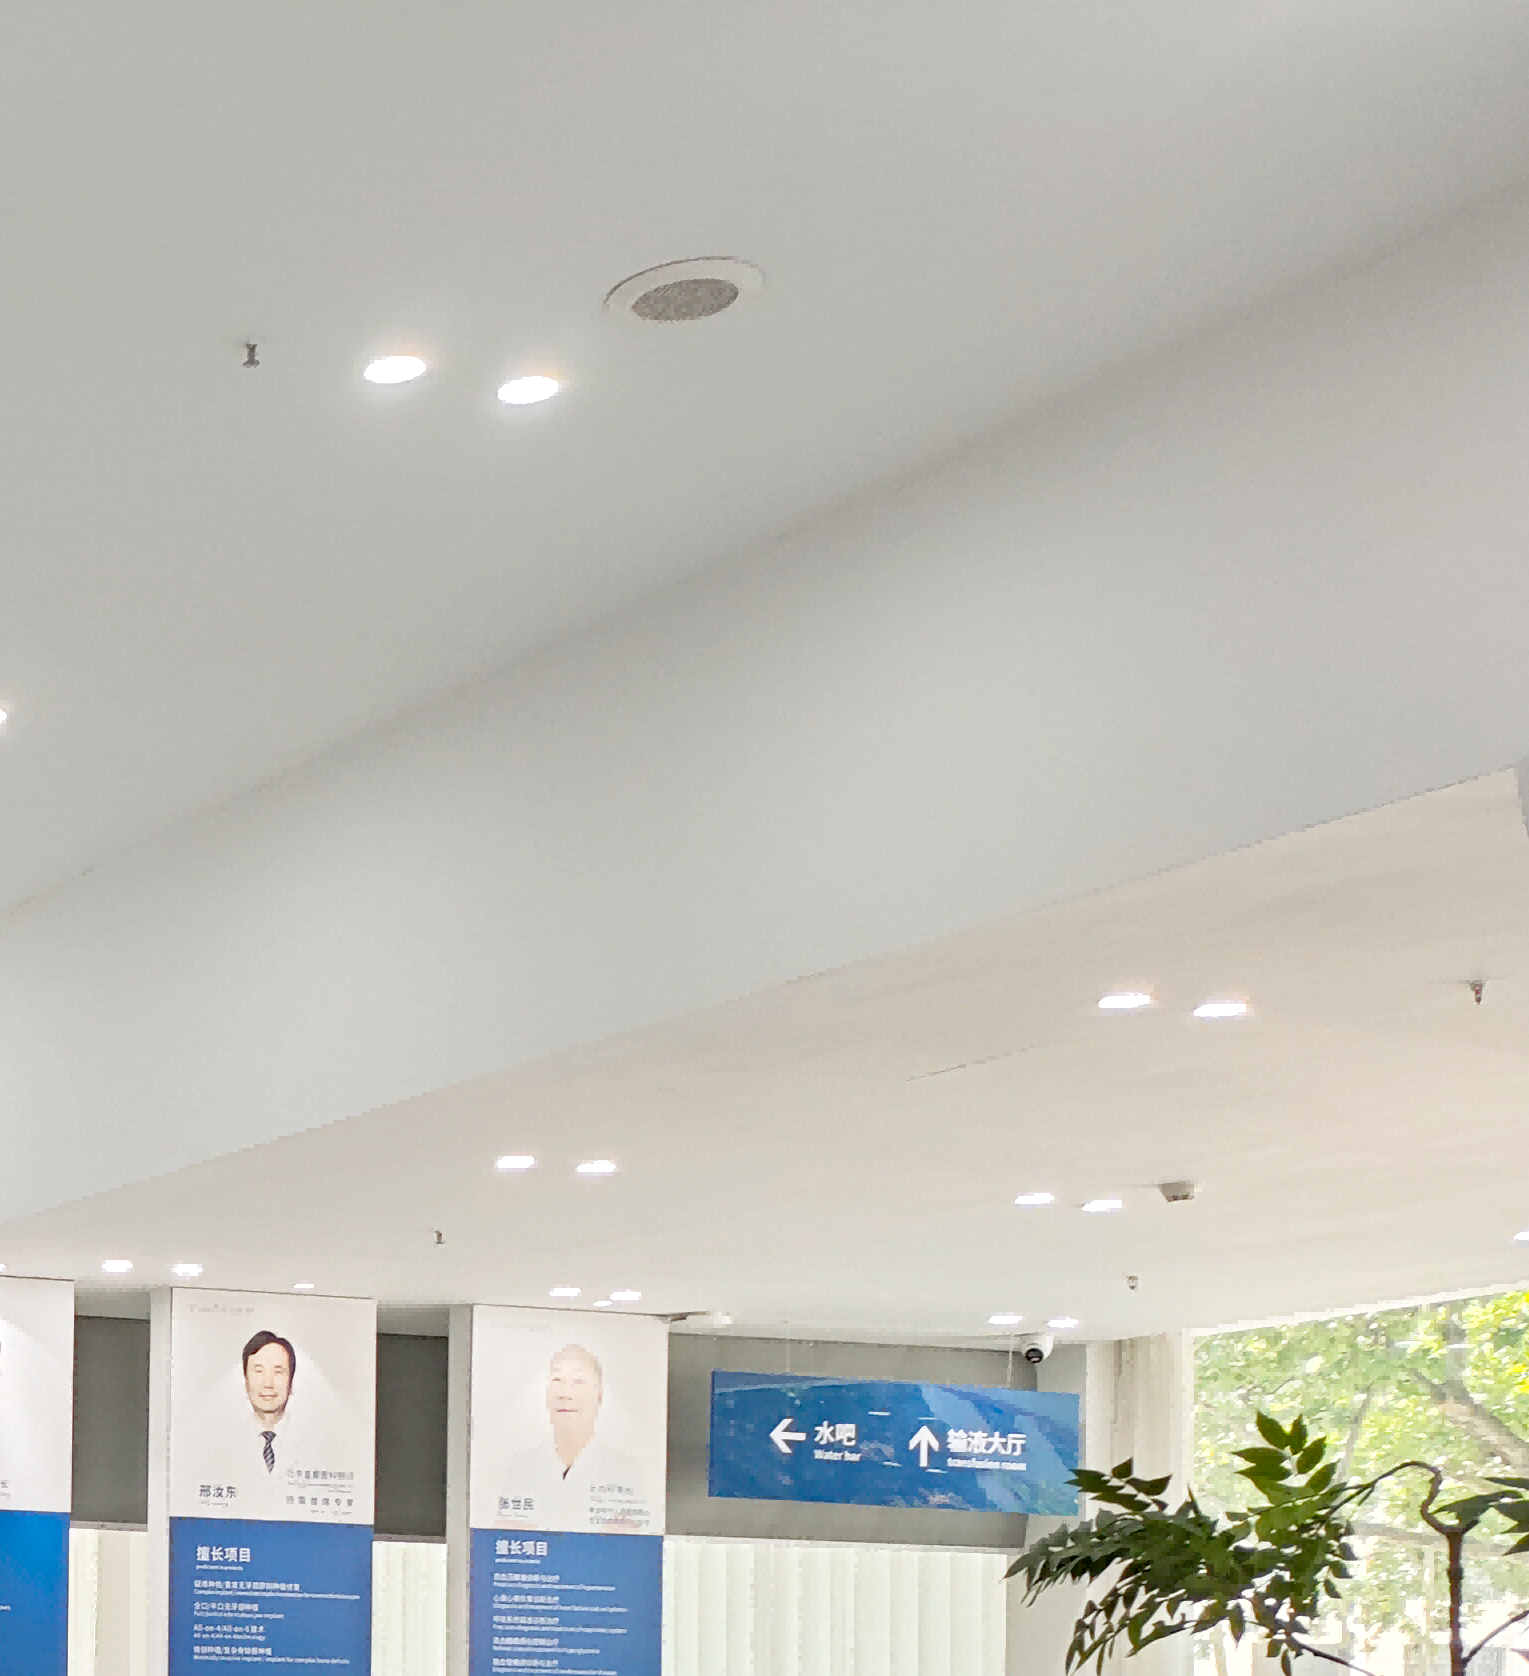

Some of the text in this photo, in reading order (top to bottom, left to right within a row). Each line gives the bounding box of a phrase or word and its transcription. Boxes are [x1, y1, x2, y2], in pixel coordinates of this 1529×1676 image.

[814, 1421, 856, 1446] 水吧
[947, 1429, 1027, 1456] 输液大厅
[197, 1546, 250, 1562] 擅长项目
